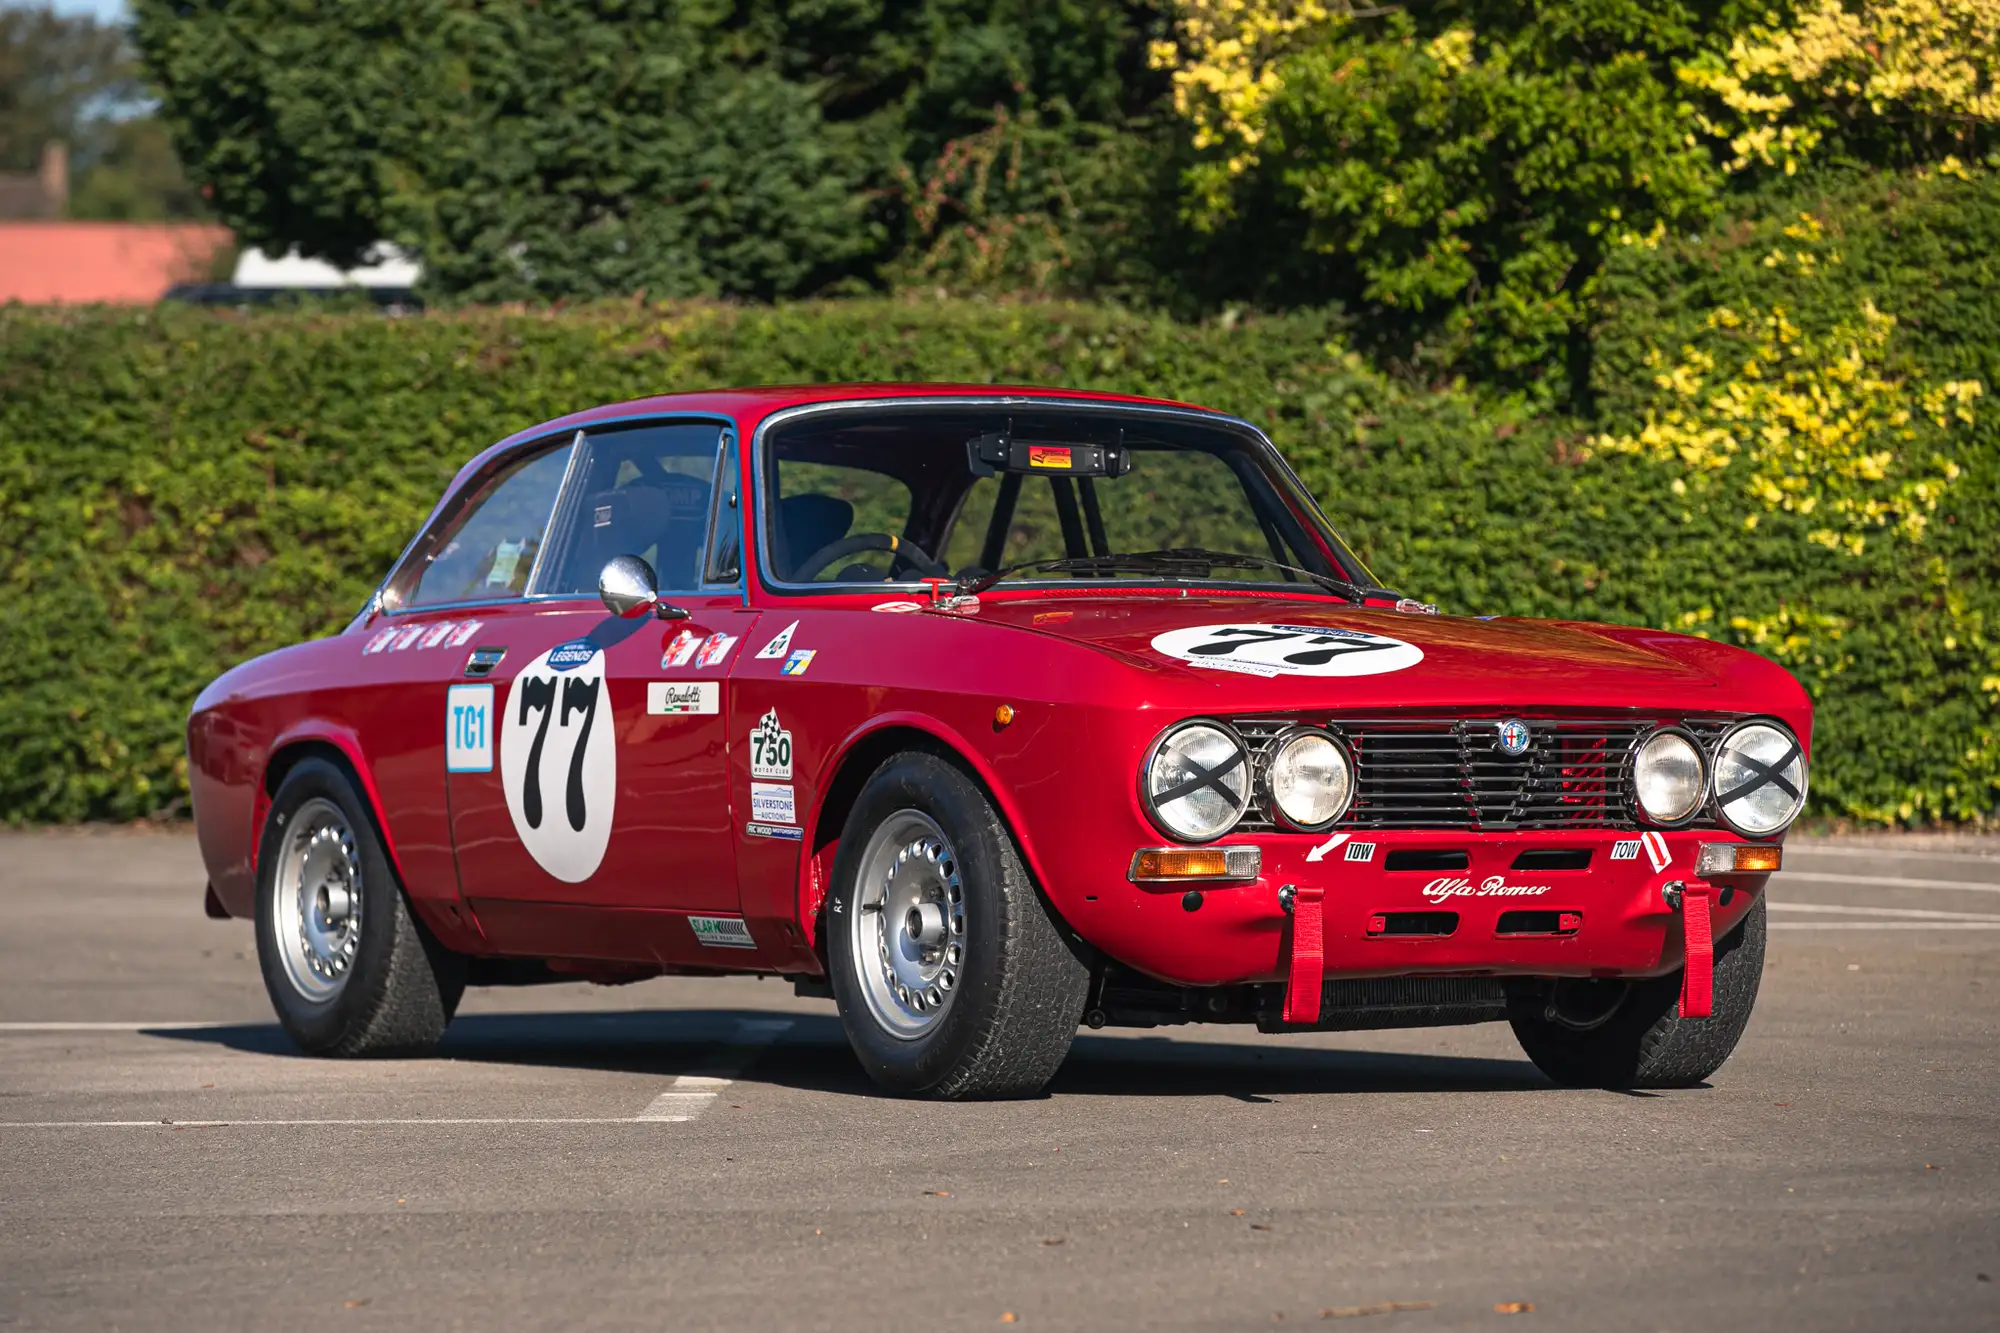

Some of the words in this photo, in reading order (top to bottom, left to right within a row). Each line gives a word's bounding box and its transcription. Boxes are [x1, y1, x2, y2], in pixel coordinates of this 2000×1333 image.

[1187, 628, 1402, 665] 77
[550, 649, 593, 662] LEGENDS
[454, 705, 485, 749] TC1
[519, 676, 600, 832] 77
[753, 737, 791, 767] 750
[775, 767, 789, 775] CLUB
[753, 798, 793, 811] SILVERSTONE
[761, 811, 786, 821] AUCTIONS
[757, 825, 772, 835] WOOD
[772, 827, 802, 836] MOTORSPORT
[1347, 844, 1373, 860] TOW
[1613, 842, 1639, 858] TOW
[1422, 878, 1476, 904] Alfa
[1476, 875, 1552, 897] Romeo
[833, 896, 843, 913] RF
